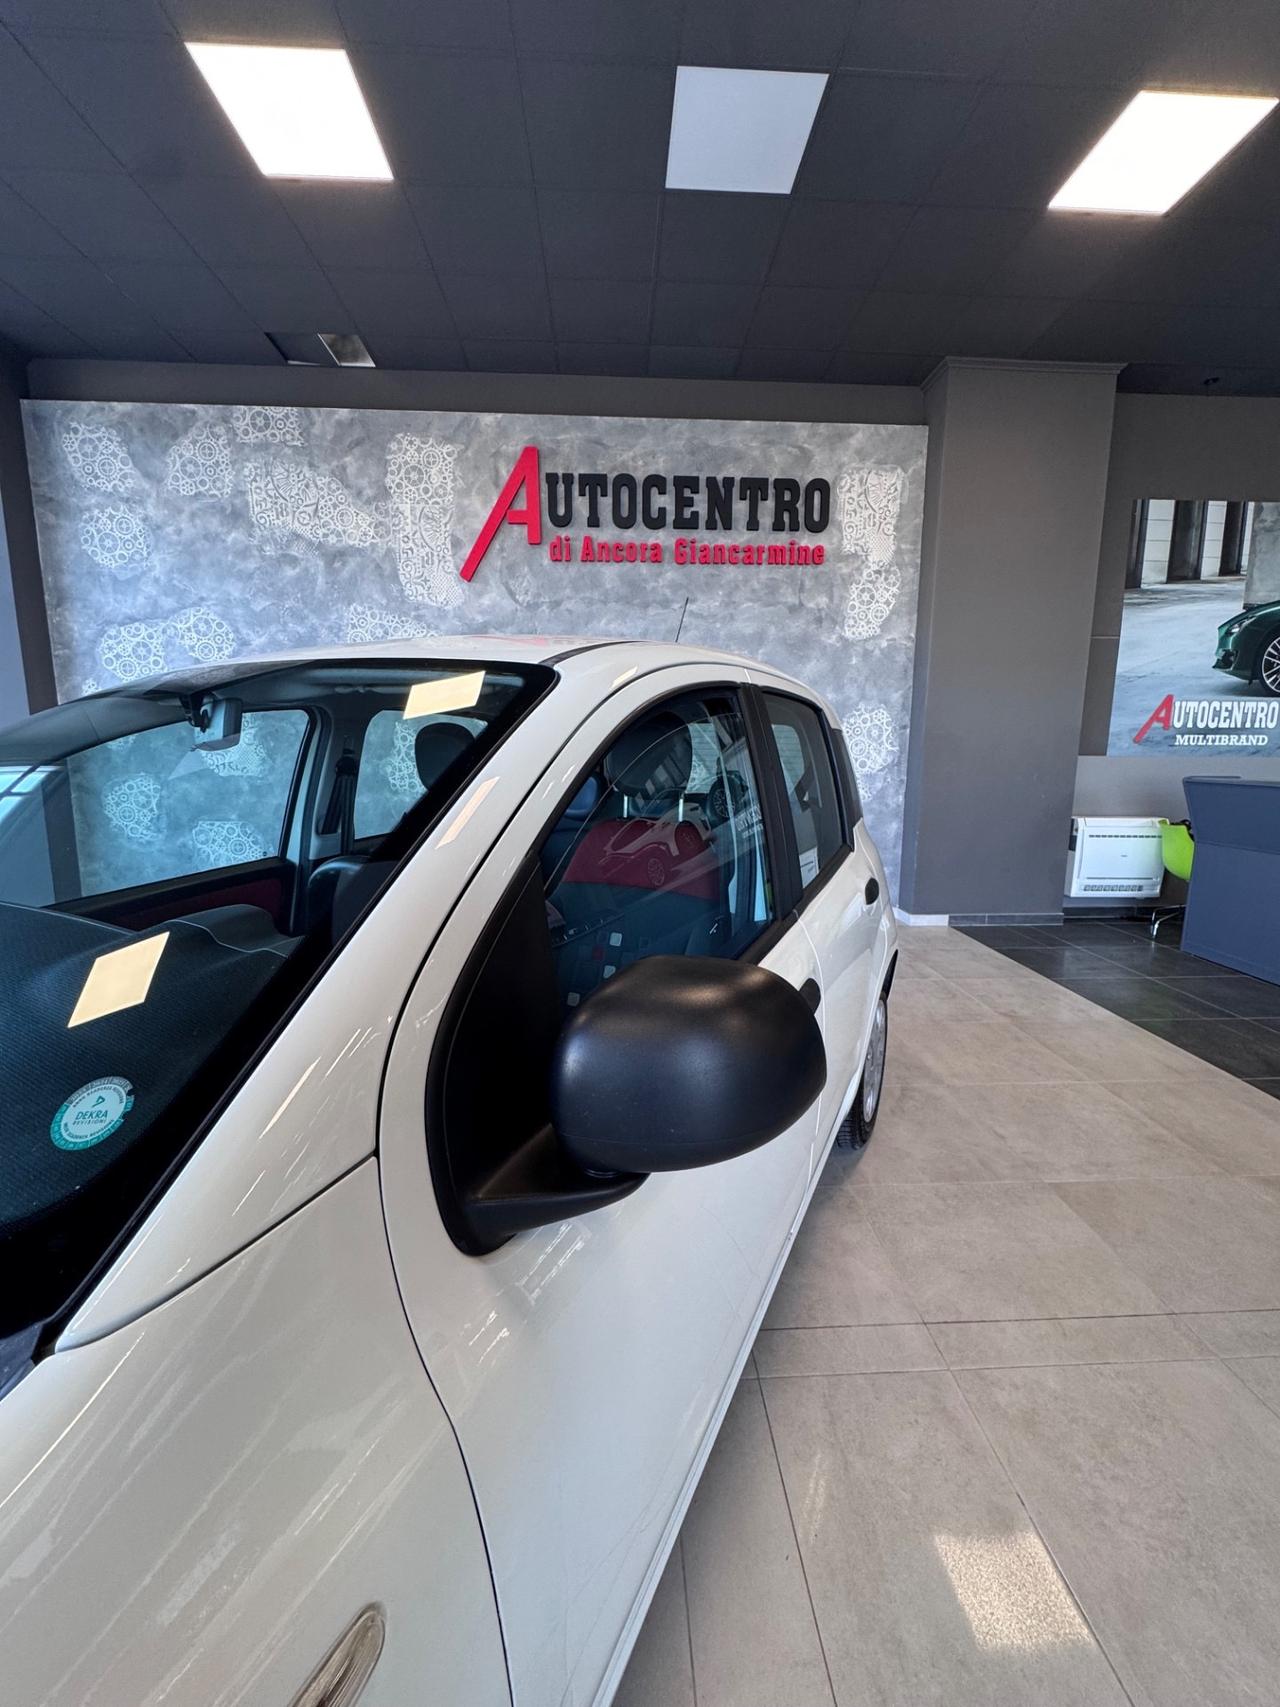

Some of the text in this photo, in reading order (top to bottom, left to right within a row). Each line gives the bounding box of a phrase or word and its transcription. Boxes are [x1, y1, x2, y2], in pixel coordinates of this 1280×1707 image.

[460, 446, 831, 582] AUTOCENTRO
[548, 536, 825, 566] di Ancora Giancarmine
[1133, 694, 1280, 744] AUTOCENTRO
[1174, 734, 1268, 746] MULTIBRAND
[75, 1109, 108, 1120] DEKRA
